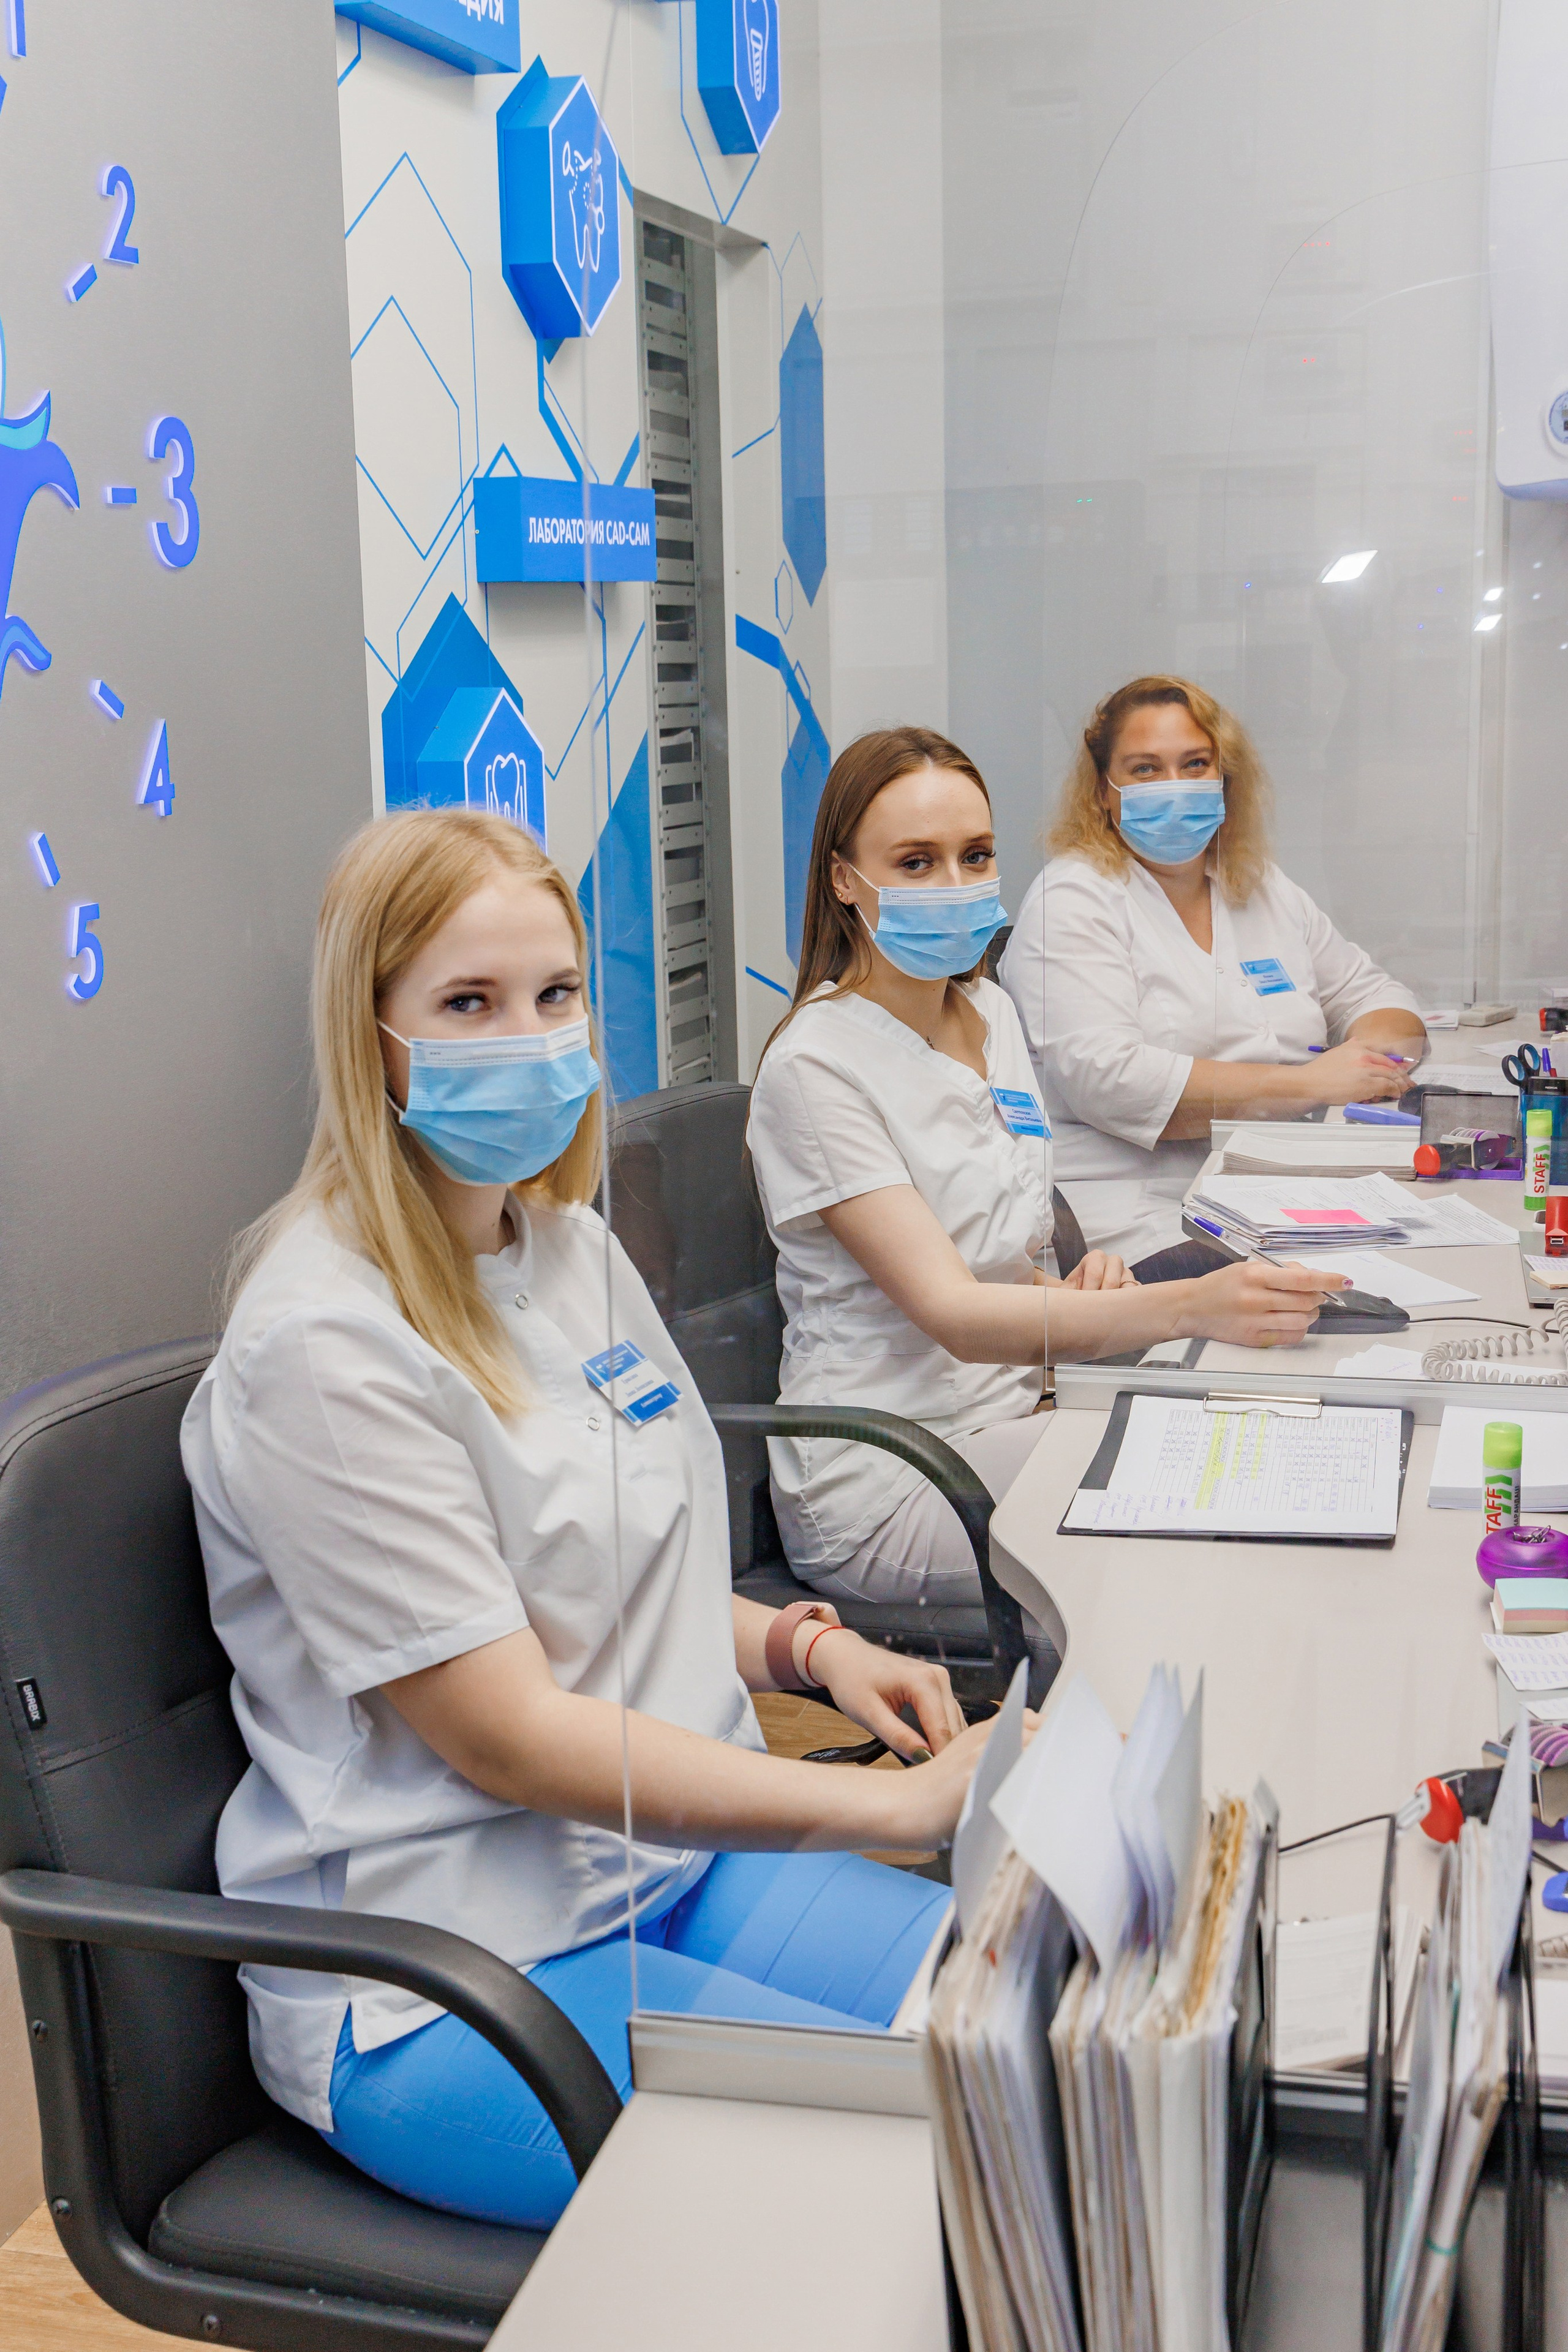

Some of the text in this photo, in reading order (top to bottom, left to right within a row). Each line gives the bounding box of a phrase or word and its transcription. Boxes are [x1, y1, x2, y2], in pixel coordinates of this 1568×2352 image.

[102, 164, 139, 264] 2
[149, 417, 200, 567] 3
[529, 517, 650, 546] ЛАБОРАТОРИЯ CAD-CAM
[136, 718, 175, 816] 4
[69, 903, 104, 999] 5
[1534, 1154, 1546, 1194] STAFF
[1486, 1487, 1502, 1535] TAFF
[23, 1684, 40, 1721] BRABIX
